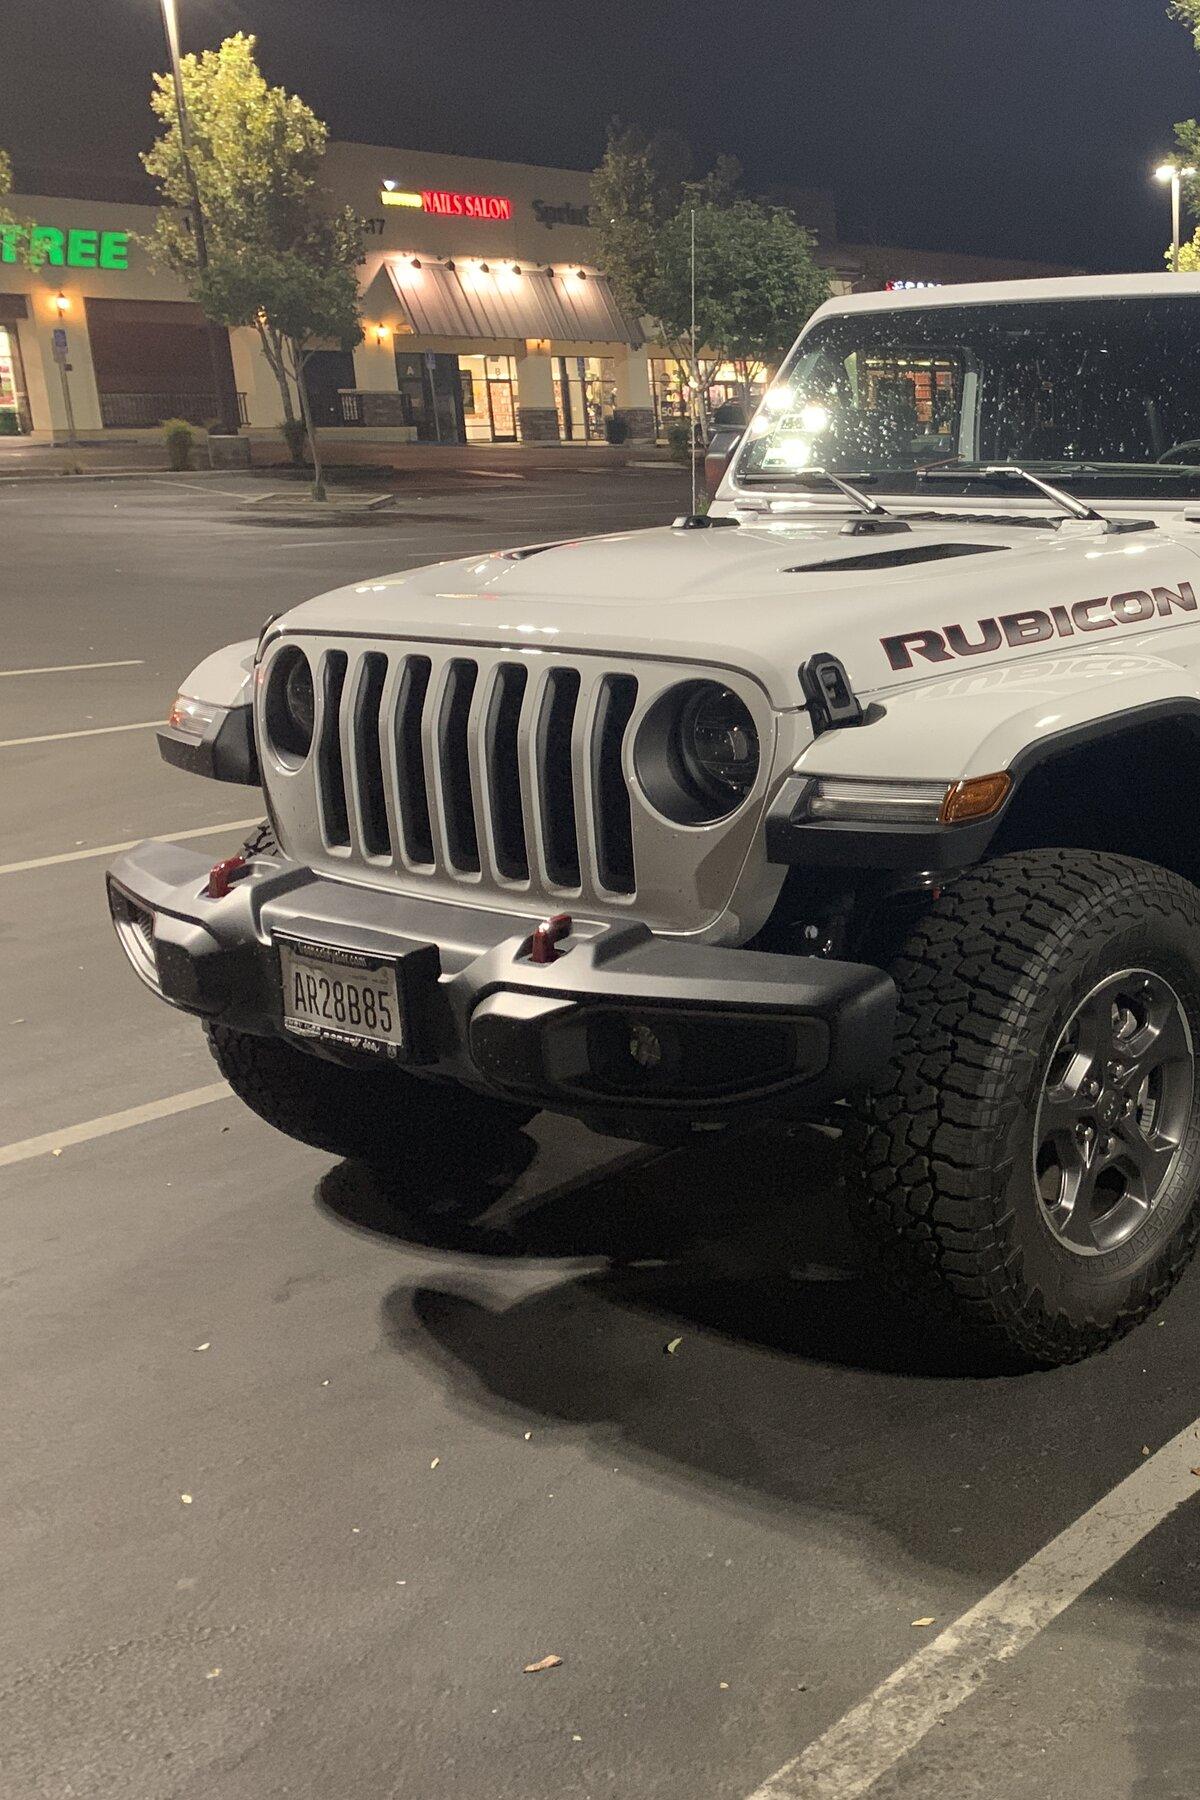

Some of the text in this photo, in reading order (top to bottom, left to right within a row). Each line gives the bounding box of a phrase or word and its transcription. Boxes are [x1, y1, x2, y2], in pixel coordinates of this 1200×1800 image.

[422, 191, 462, 215] NAILS
[464, 196, 510, 220] SALON
[0, 224, 129, 270] TREE
[879, 581, 1198, 671] RUBICON
[294, 971, 393, 1033] AR28B85
